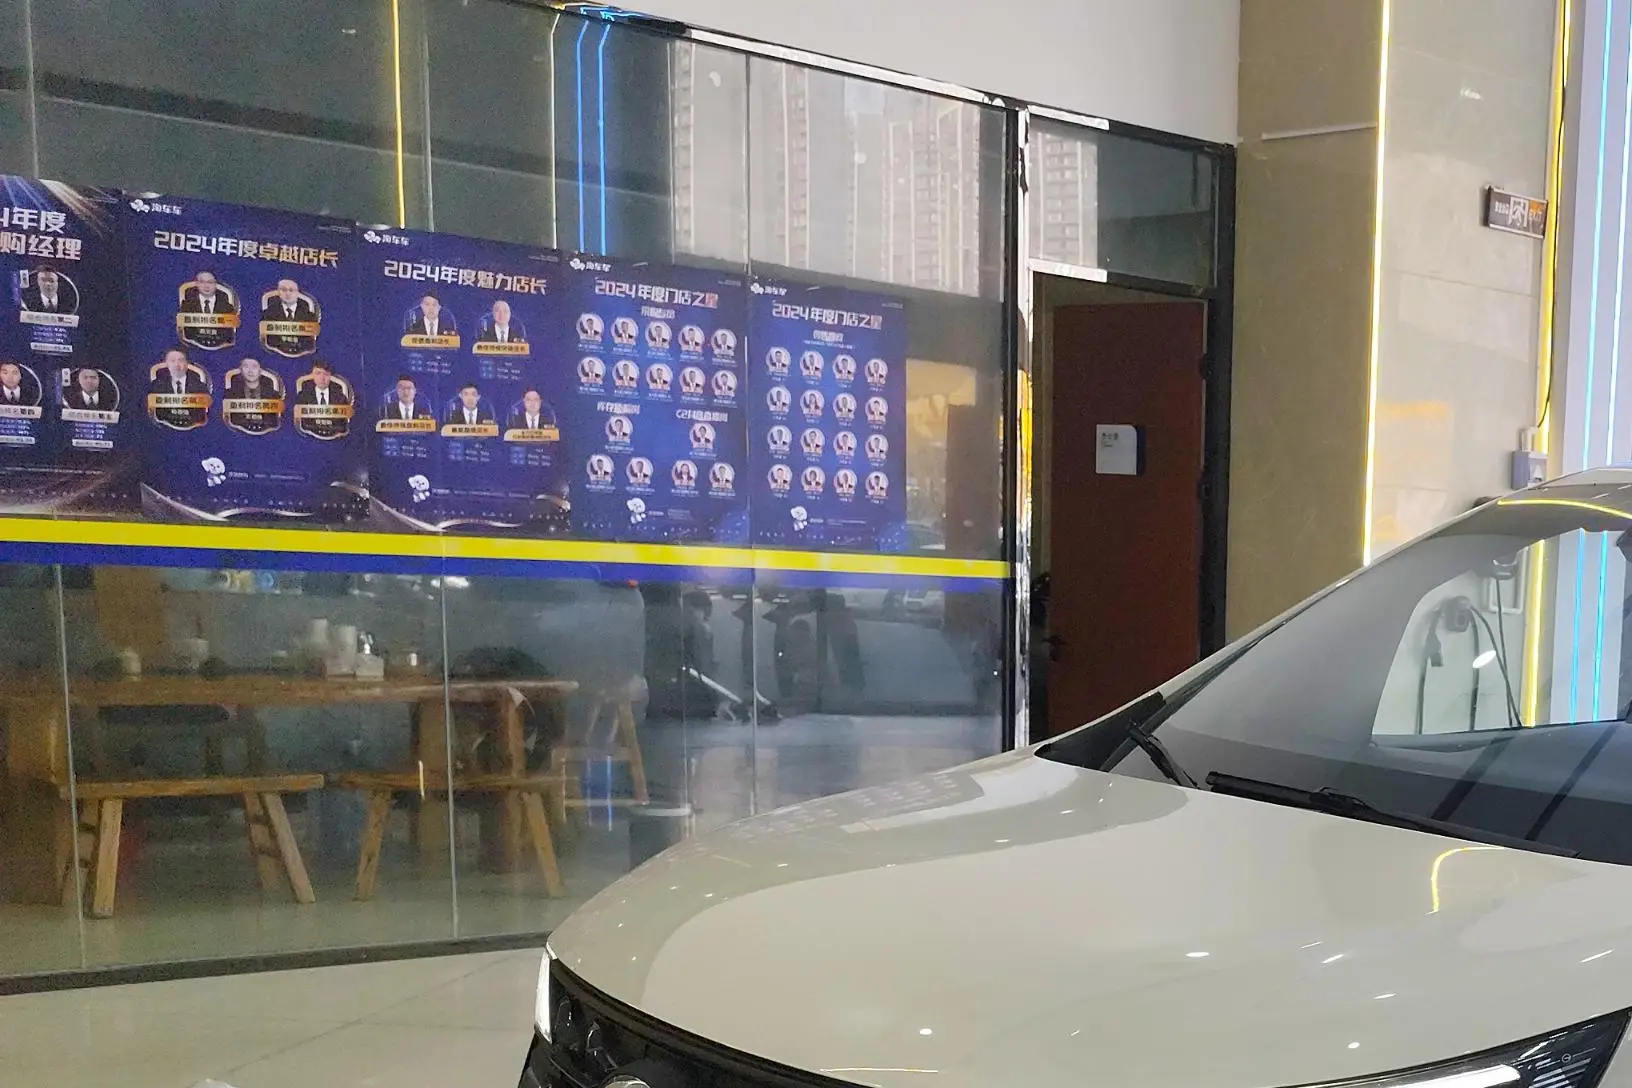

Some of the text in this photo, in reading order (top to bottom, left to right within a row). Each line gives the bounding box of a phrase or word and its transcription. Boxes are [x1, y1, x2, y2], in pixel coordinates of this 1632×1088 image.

[0, 231, 82, 260] 购经理
[153, 230, 339, 268] 2024年度卓越店长
[384, 259, 548, 296] 2024年度魅力店长
[595, 279, 719, 309] 2024年度门店之星
[772, 303, 883, 330] 2024年度门店之星
